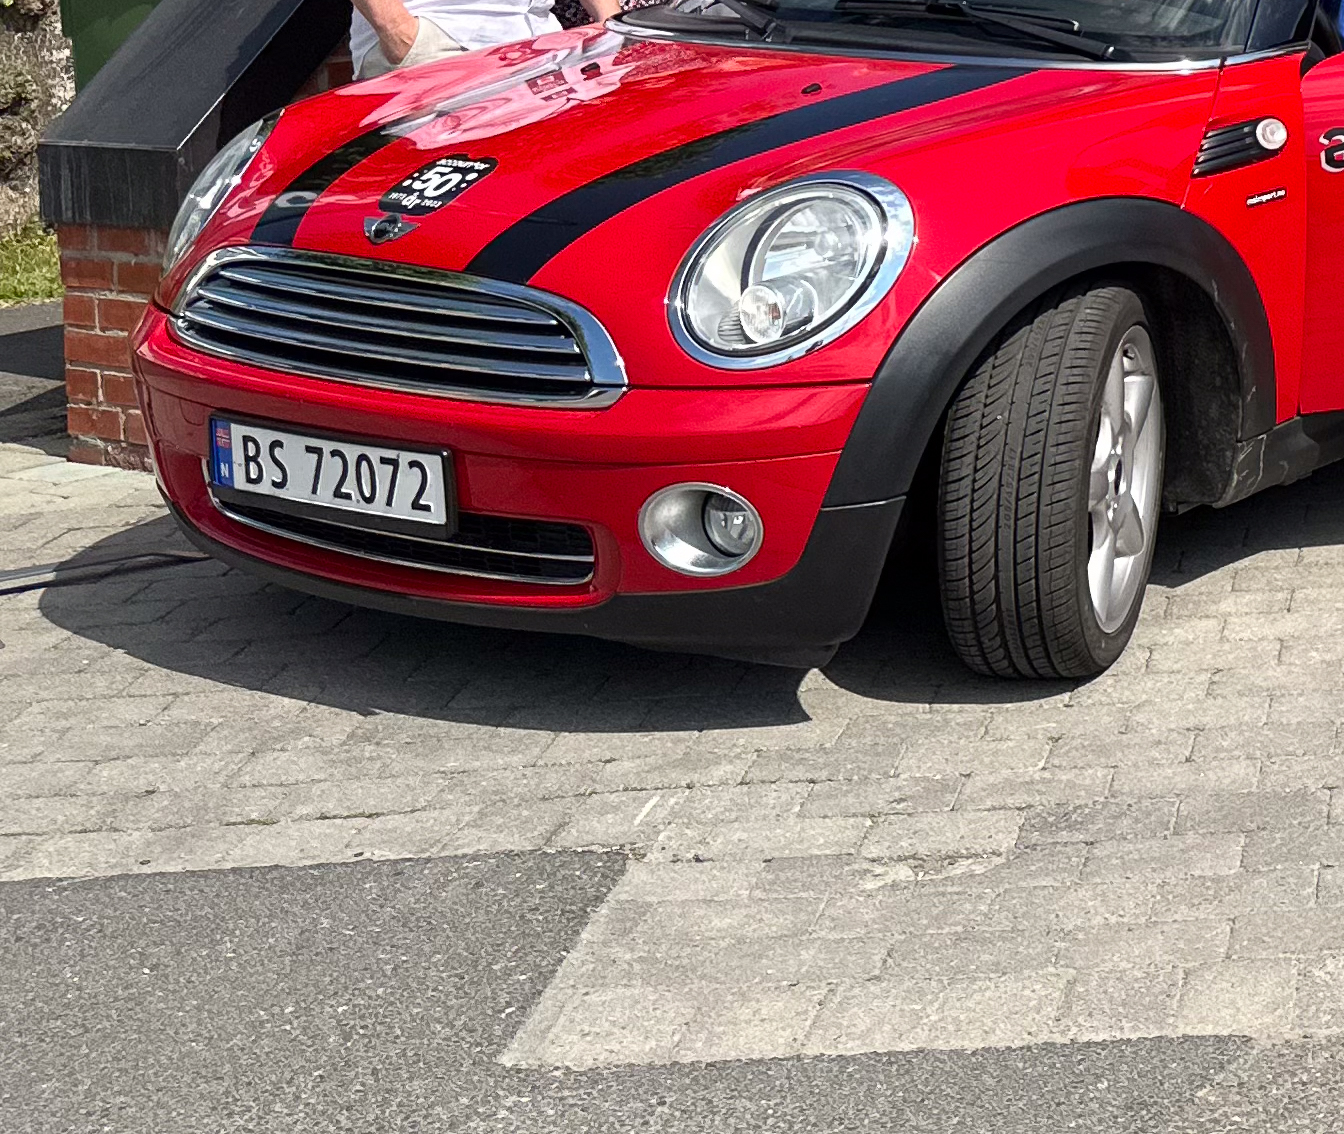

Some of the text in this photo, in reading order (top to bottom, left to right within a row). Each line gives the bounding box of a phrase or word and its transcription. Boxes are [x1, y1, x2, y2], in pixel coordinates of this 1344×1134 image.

[412, 166, 463, 198] 50
[220, 435, 433, 513] N BS 72072
